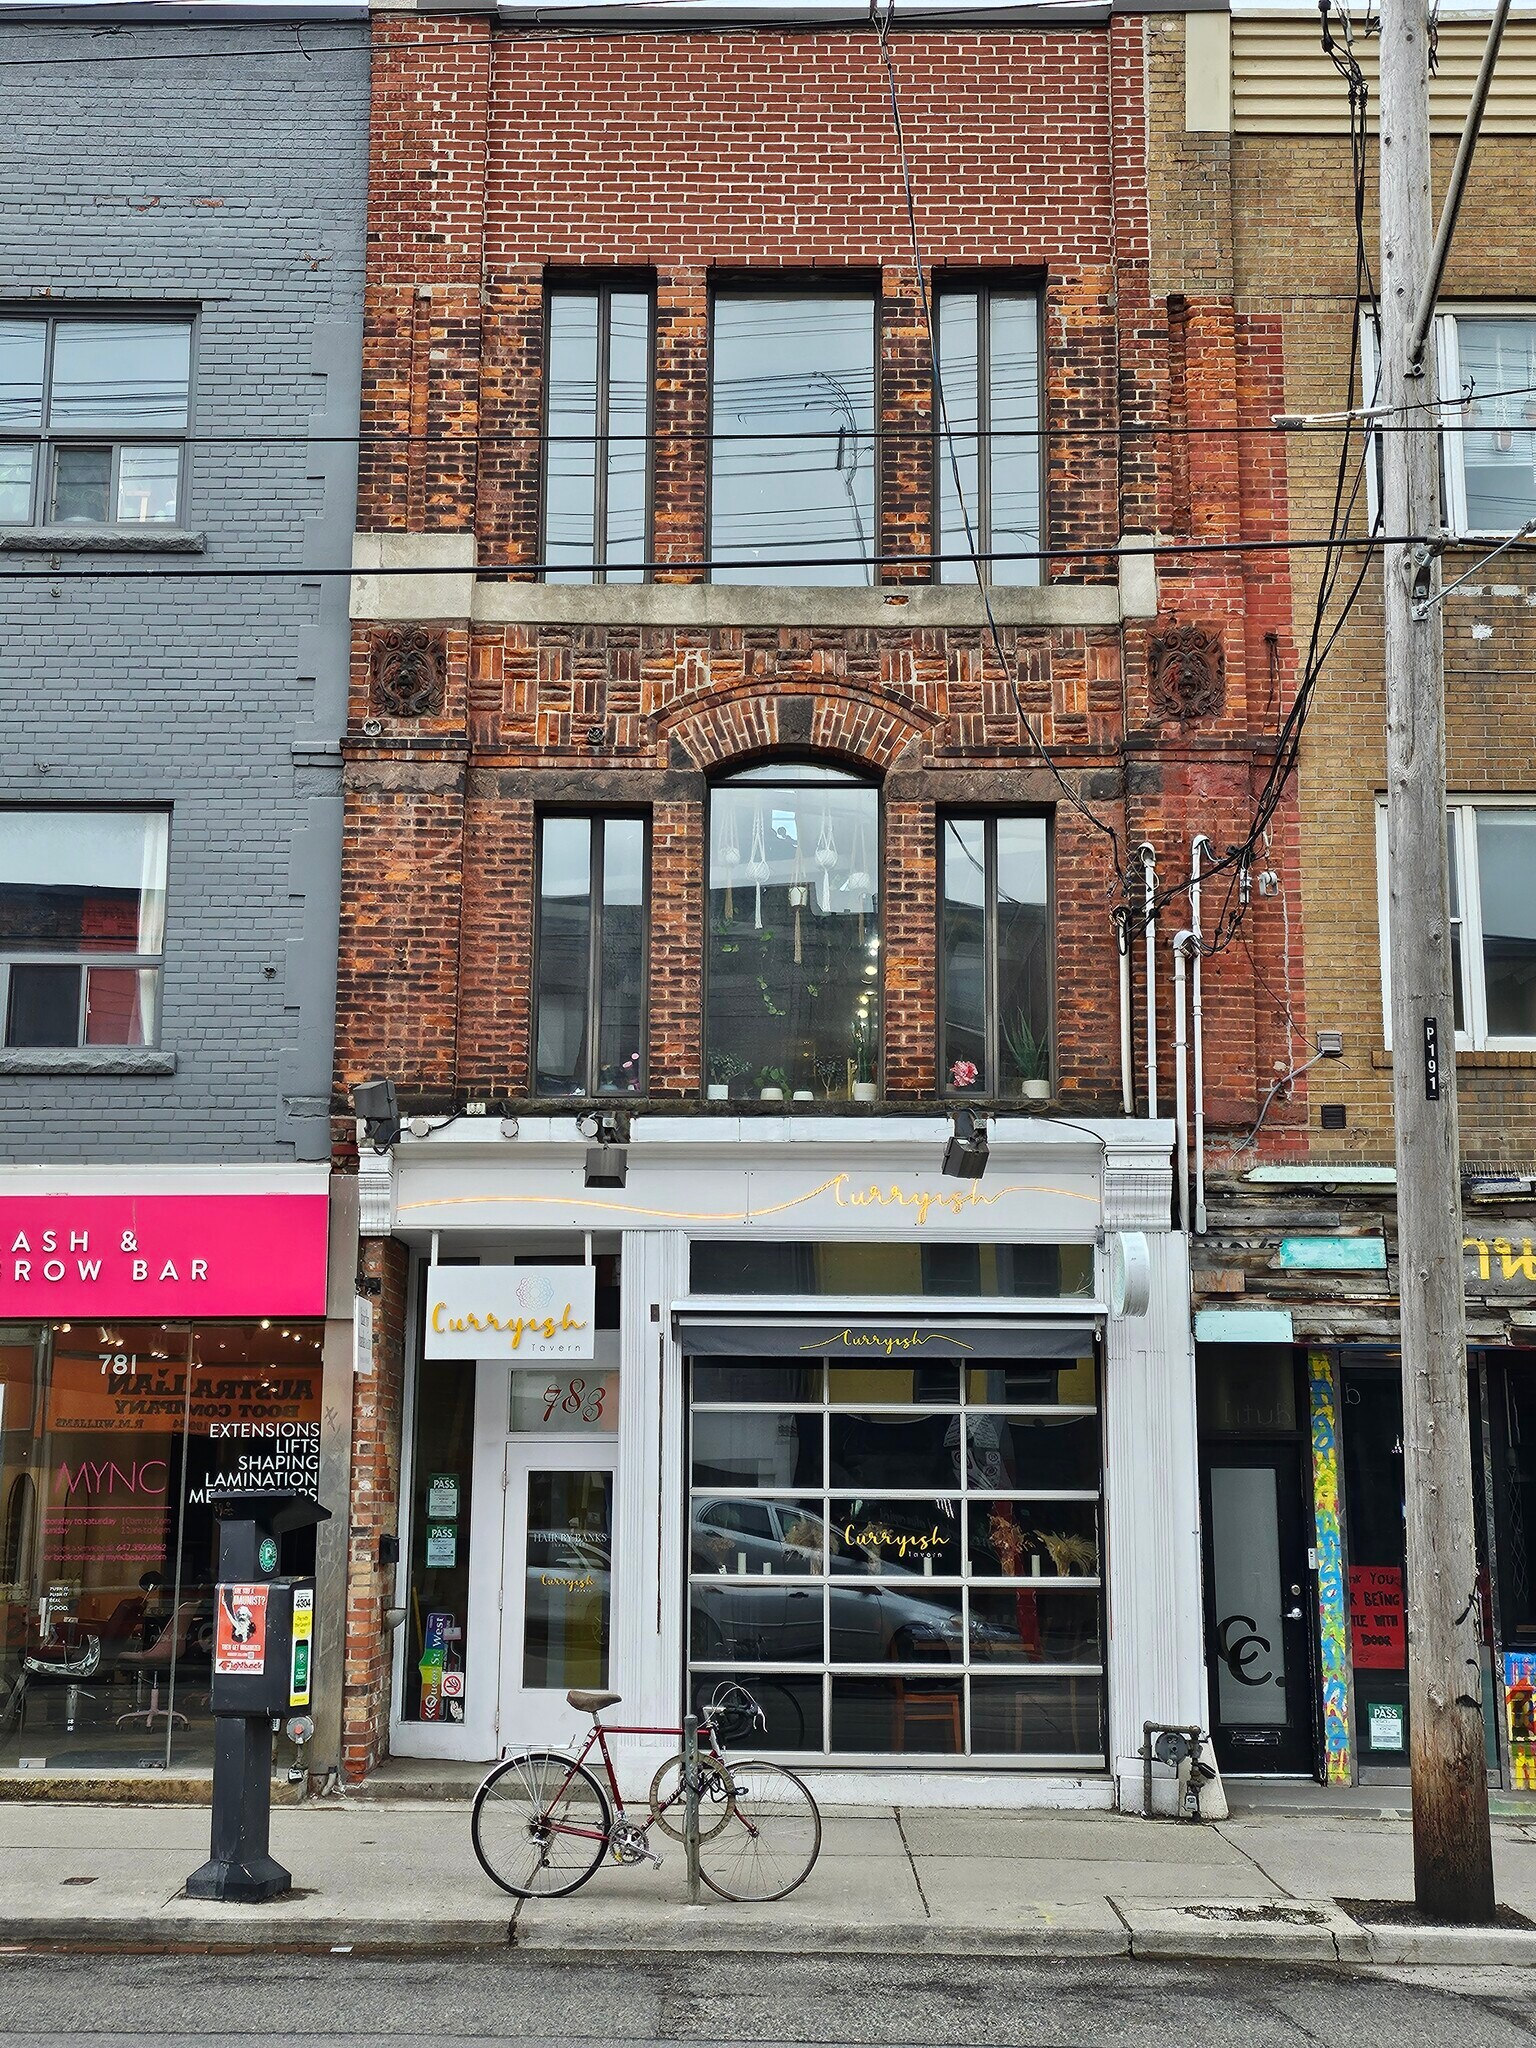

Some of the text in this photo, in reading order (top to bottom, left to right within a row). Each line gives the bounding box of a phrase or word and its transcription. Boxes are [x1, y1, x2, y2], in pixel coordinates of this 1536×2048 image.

[1425, 1027, 1437, 1091] P191
[833, 1173, 992, 1225] Curryish
[120, 1230, 138, 1252] &
[132, 1260, 208, 1281] BAR
[432, 1302, 587, 1350] Curryish
[531, 1342, 581, 1353] Tavern
[843, 1329, 924, 1354] Curryish
[98, 1354, 137, 1375] 781
[543, 1378, 606, 1423] 783
[209, 1422, 320, 1438] EXTENSIONS
[276, 1438, 320, 1454] LIFTS
[238, 1455, 319, 1471] SHAPING
[53, 1461, 167, 1494] MYNC
[205, 1471, 318, 1487] LAMINATION
[433, 1479, 455, 1489] PASS
[431, 1529, 453, 1538] PASS
[533, 1533, 558, 1542] HAIR
[575, 1533, 608, 1543] BANKS
[843, 1523, 950, 1558] Curryish
[541, 1573, 594, 1592] Curryish
[1370, 1572, 1395, 1584] YOU
[432, 1616, 445, 1648] West
[1374, 1708, 1398, 1719] PASS
